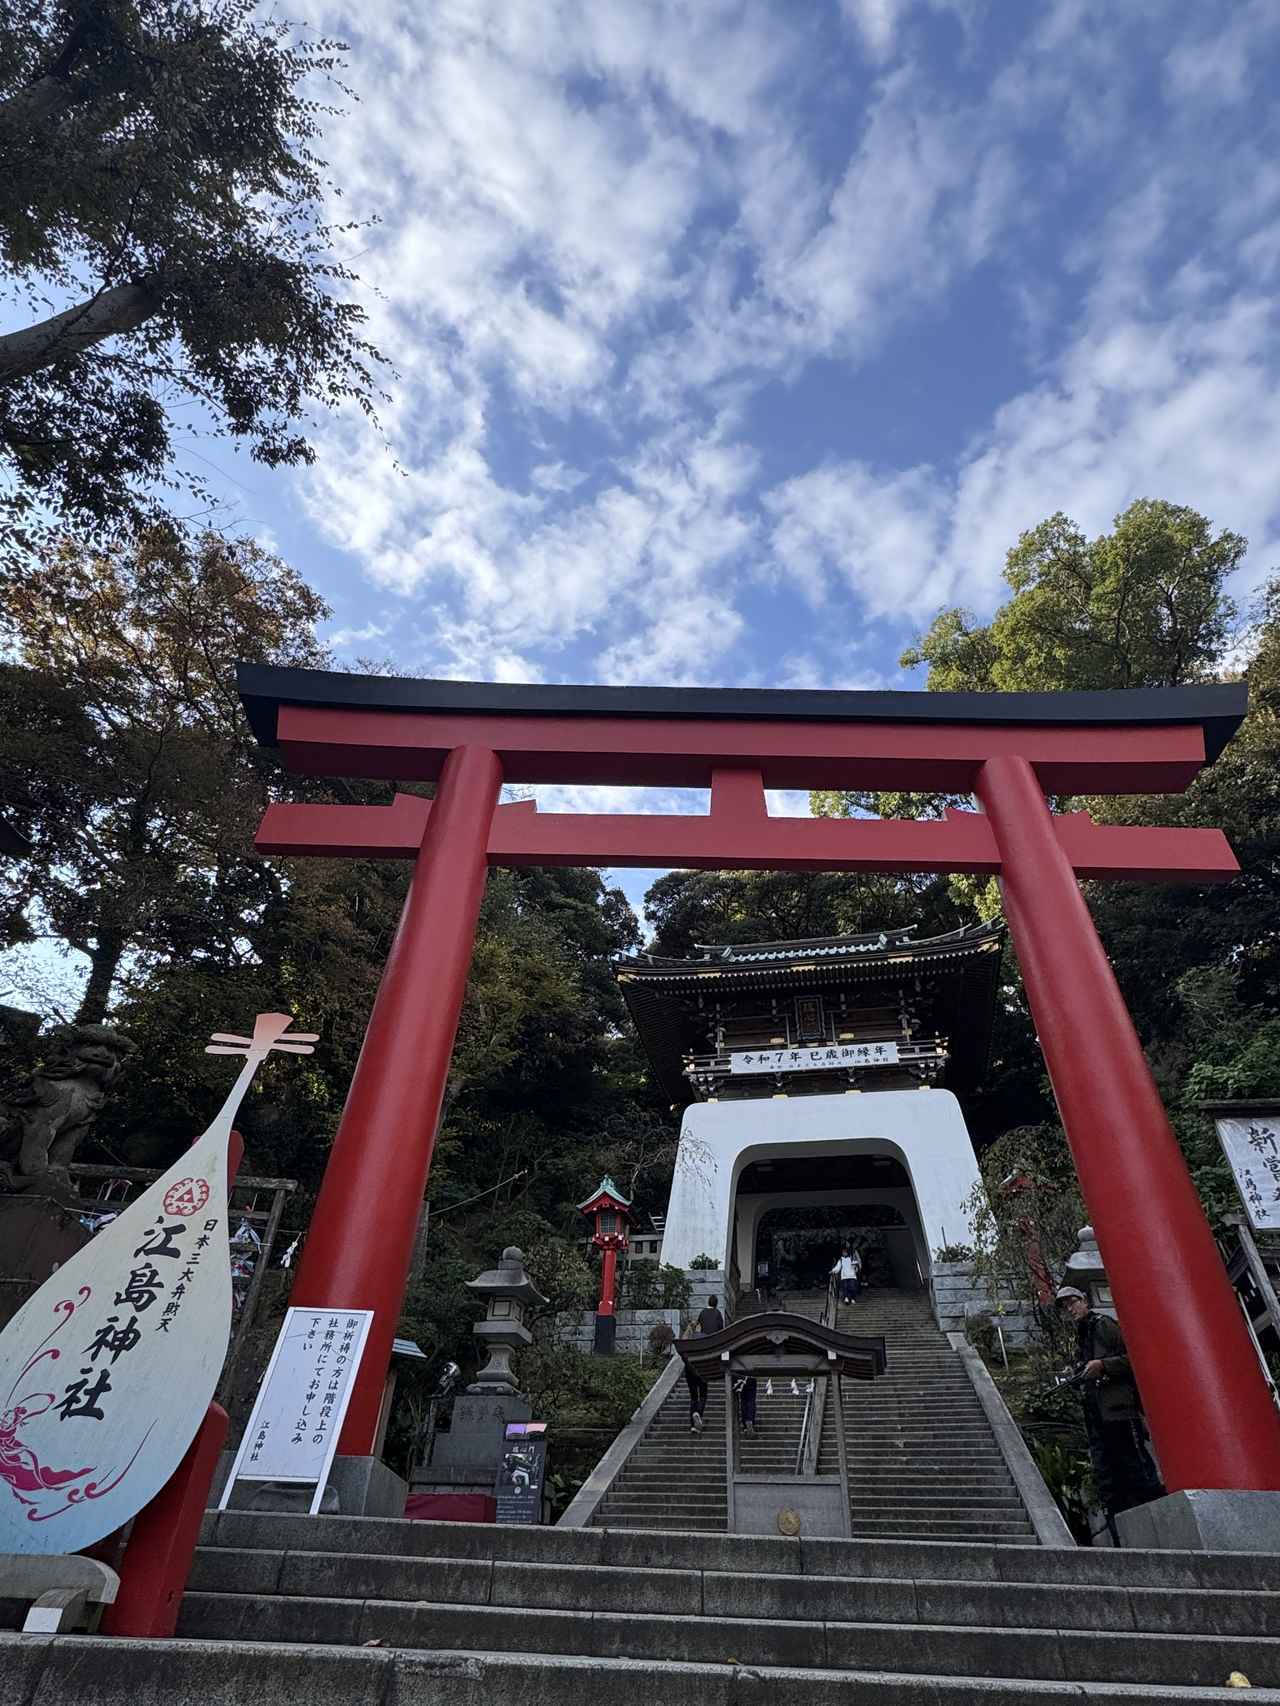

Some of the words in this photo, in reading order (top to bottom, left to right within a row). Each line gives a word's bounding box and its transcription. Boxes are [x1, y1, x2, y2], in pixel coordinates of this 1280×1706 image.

[54, 1215, 187, 1421] 江島神社
[155, 1218, 219, 1334] 日本三大弁財天
[302, 1317, 322, 1351] 下さい
[291, 1317, 339, 1445] 社務所にてお申し込み
[250, 1421, 271, 1462] 江島神社
